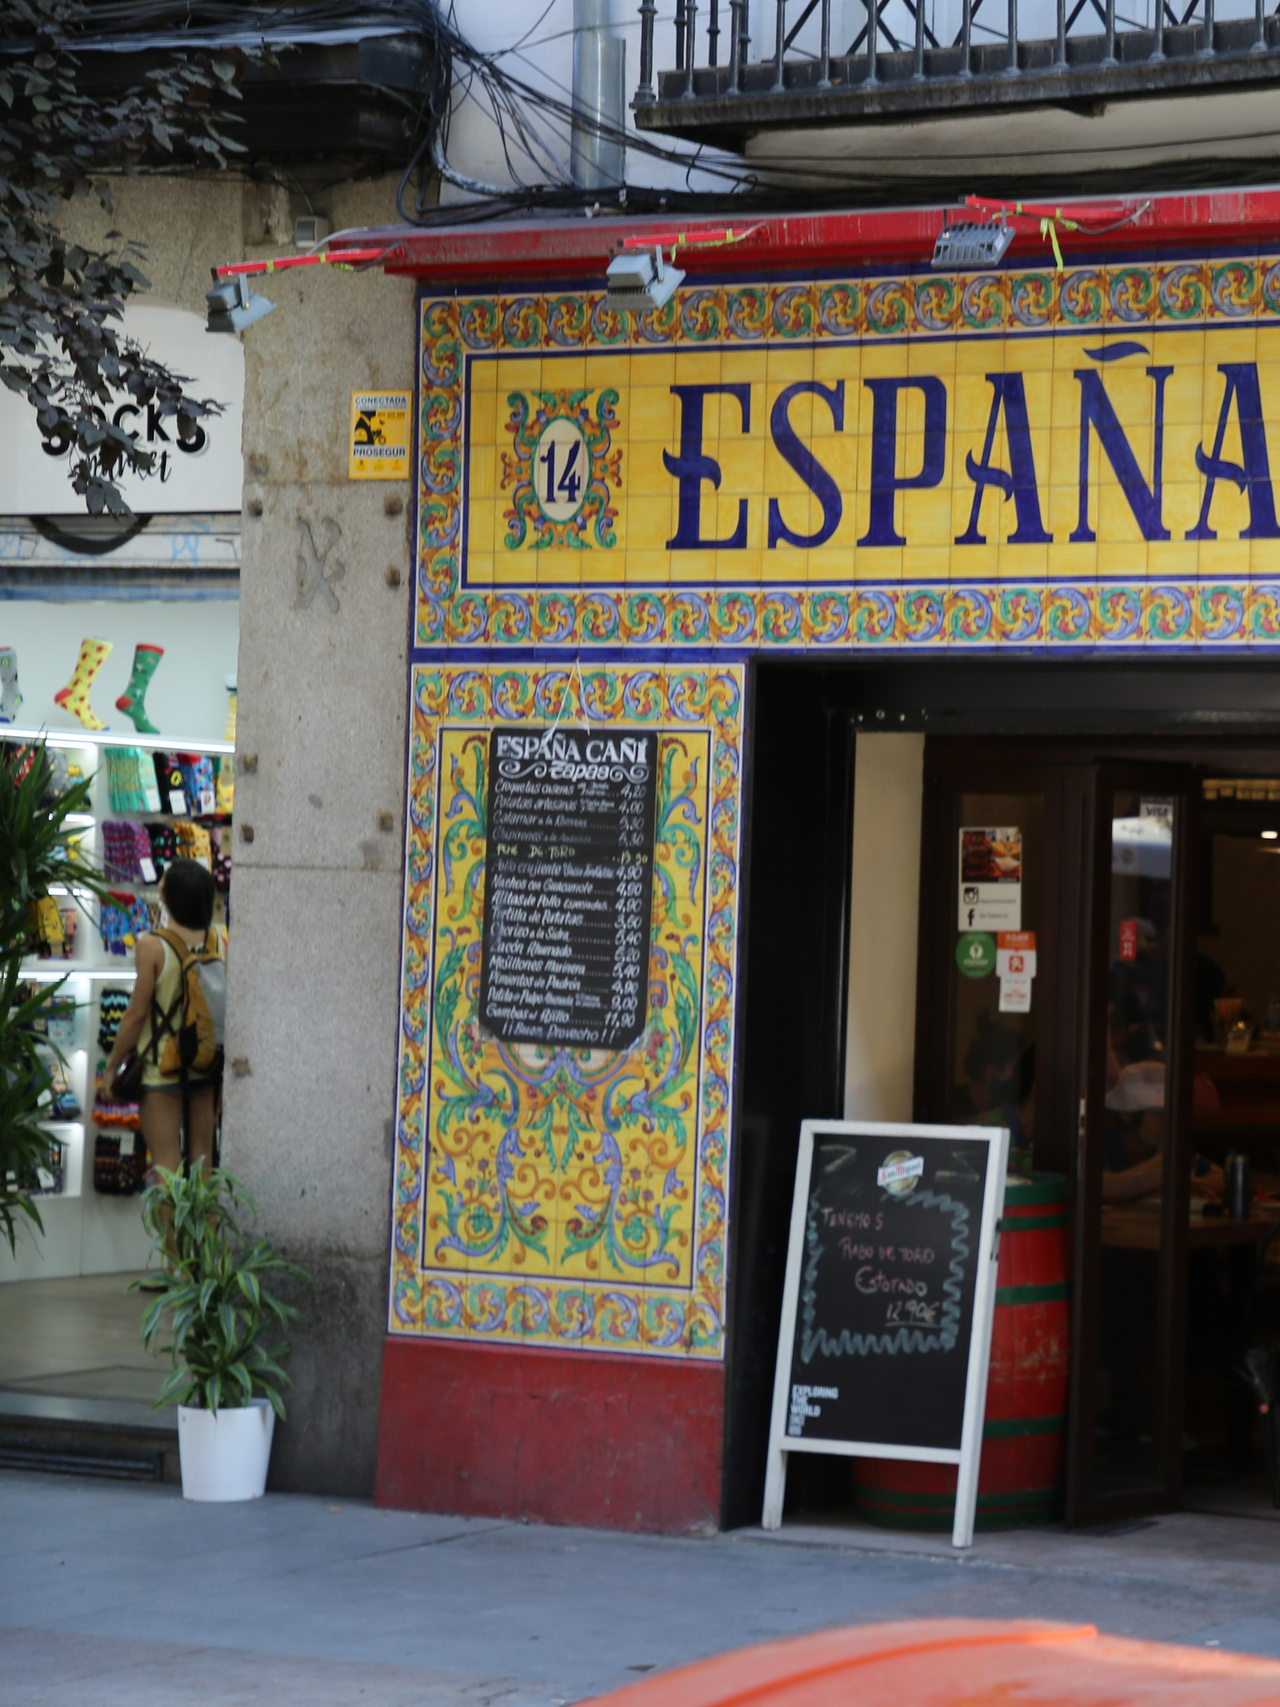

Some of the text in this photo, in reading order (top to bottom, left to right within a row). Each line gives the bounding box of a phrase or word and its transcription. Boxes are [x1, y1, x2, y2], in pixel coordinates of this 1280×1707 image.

[353, 447, 406, 457] PROSEGUR
[540, 438, 582, 503] 14
[496, 731, 581, 762] ESPAÑA
